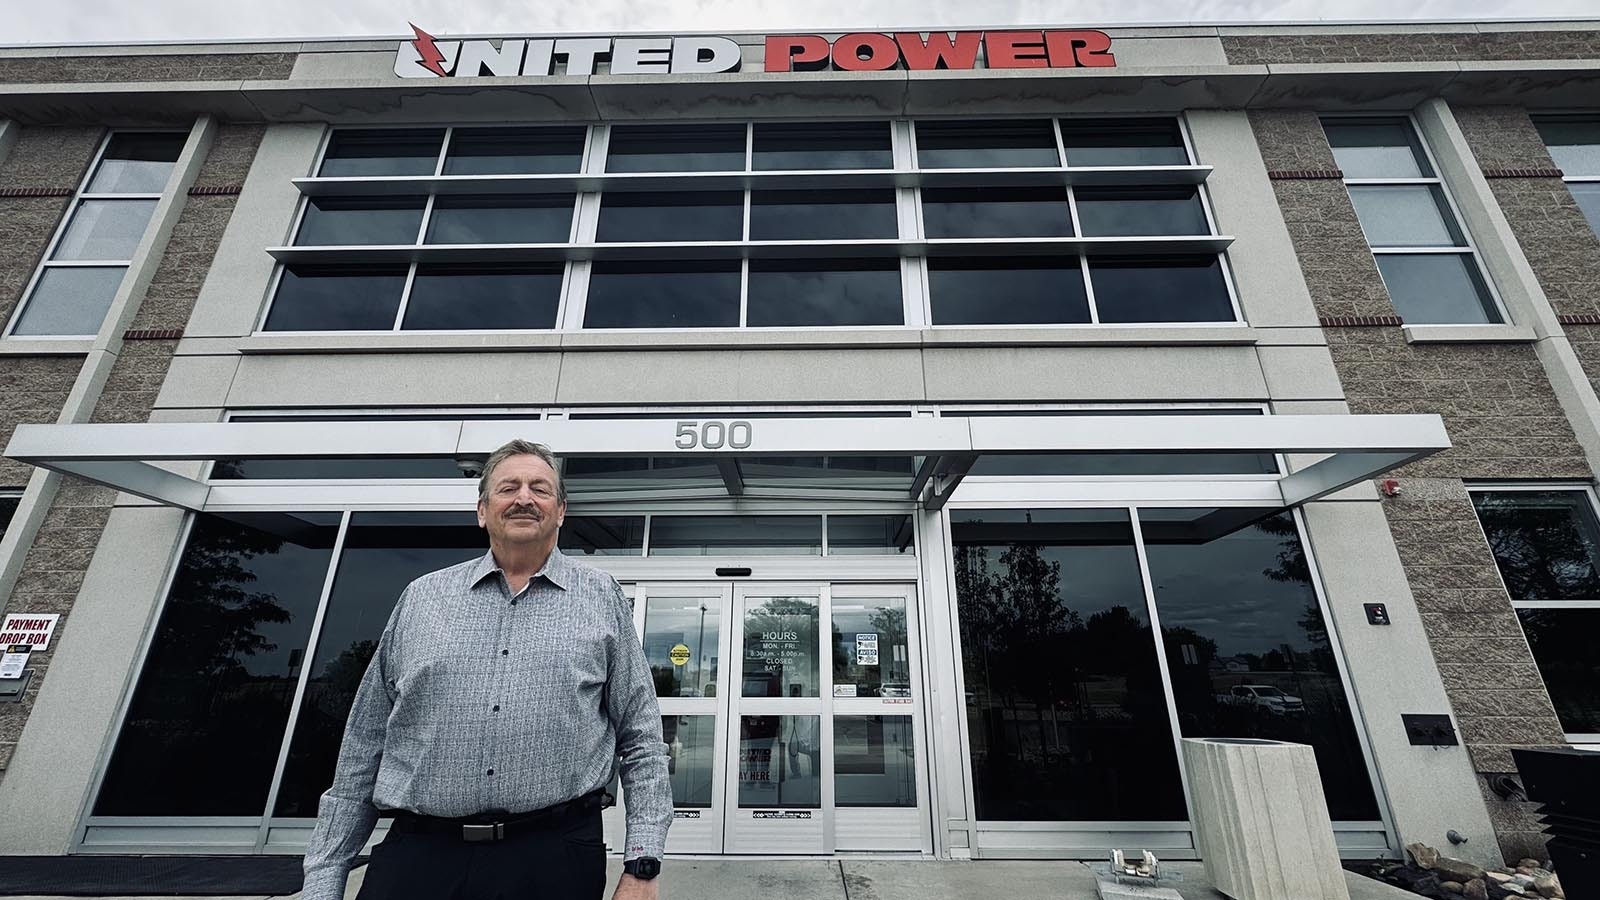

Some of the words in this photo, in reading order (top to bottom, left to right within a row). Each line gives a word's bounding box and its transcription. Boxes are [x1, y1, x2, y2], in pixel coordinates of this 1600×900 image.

[393, 34, 742, 78] UNITED
[764, 29, 1118, 72] POWER
[675, 421, 752, 449] 500
[6, 619, 52, 630] PAYMENT
[0, 633, 25, 644] DROP
[26, 633, 48, 644] BOX
[762, 631, 798, 640] HOURS
[739, 771, 748, 780] AY
[750, 771, 770, 781] HERE
